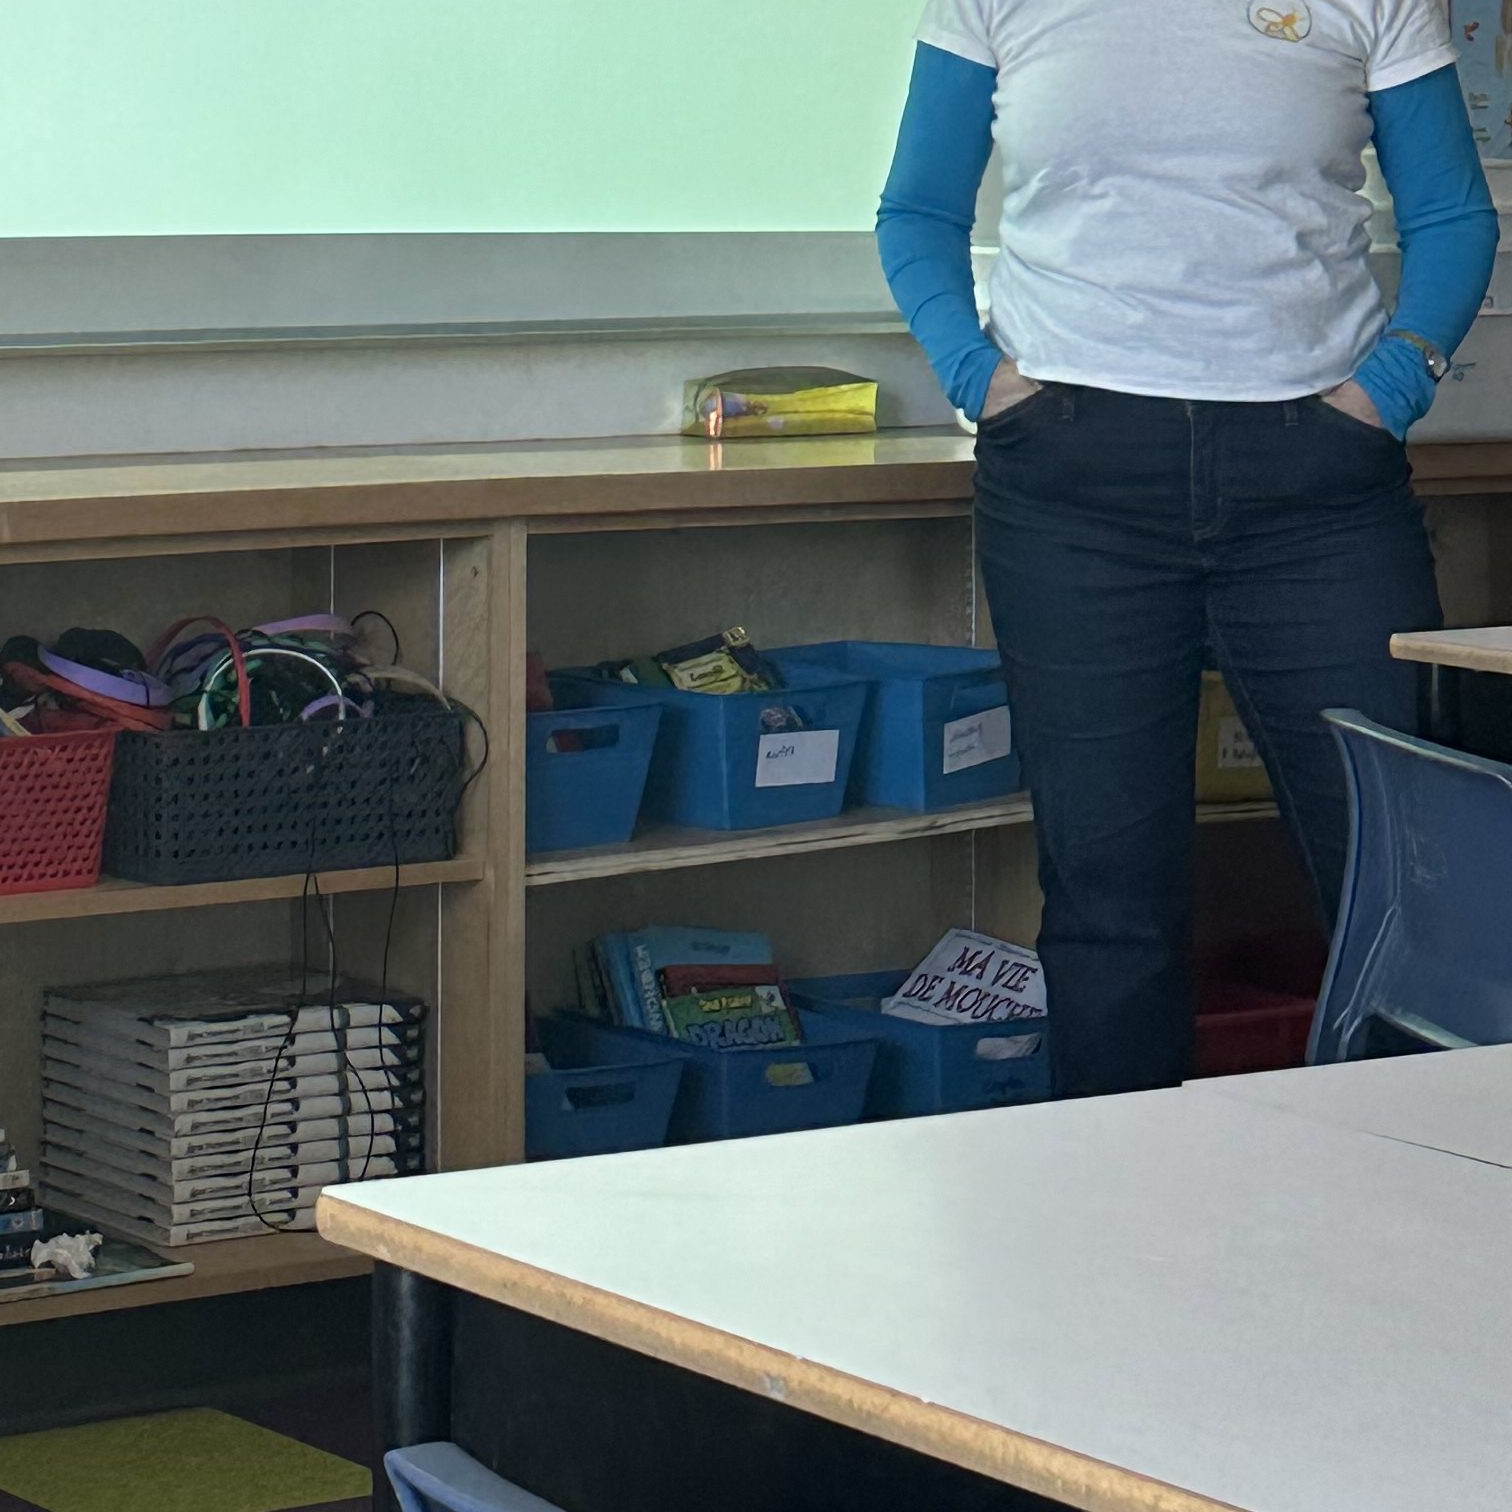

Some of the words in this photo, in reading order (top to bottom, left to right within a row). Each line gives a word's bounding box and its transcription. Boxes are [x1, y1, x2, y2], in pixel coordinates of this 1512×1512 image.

[902, 974, 944, 1001] DE
[948, 946, 995, 980] MA
[992, 960, 1038, 993] VIE
